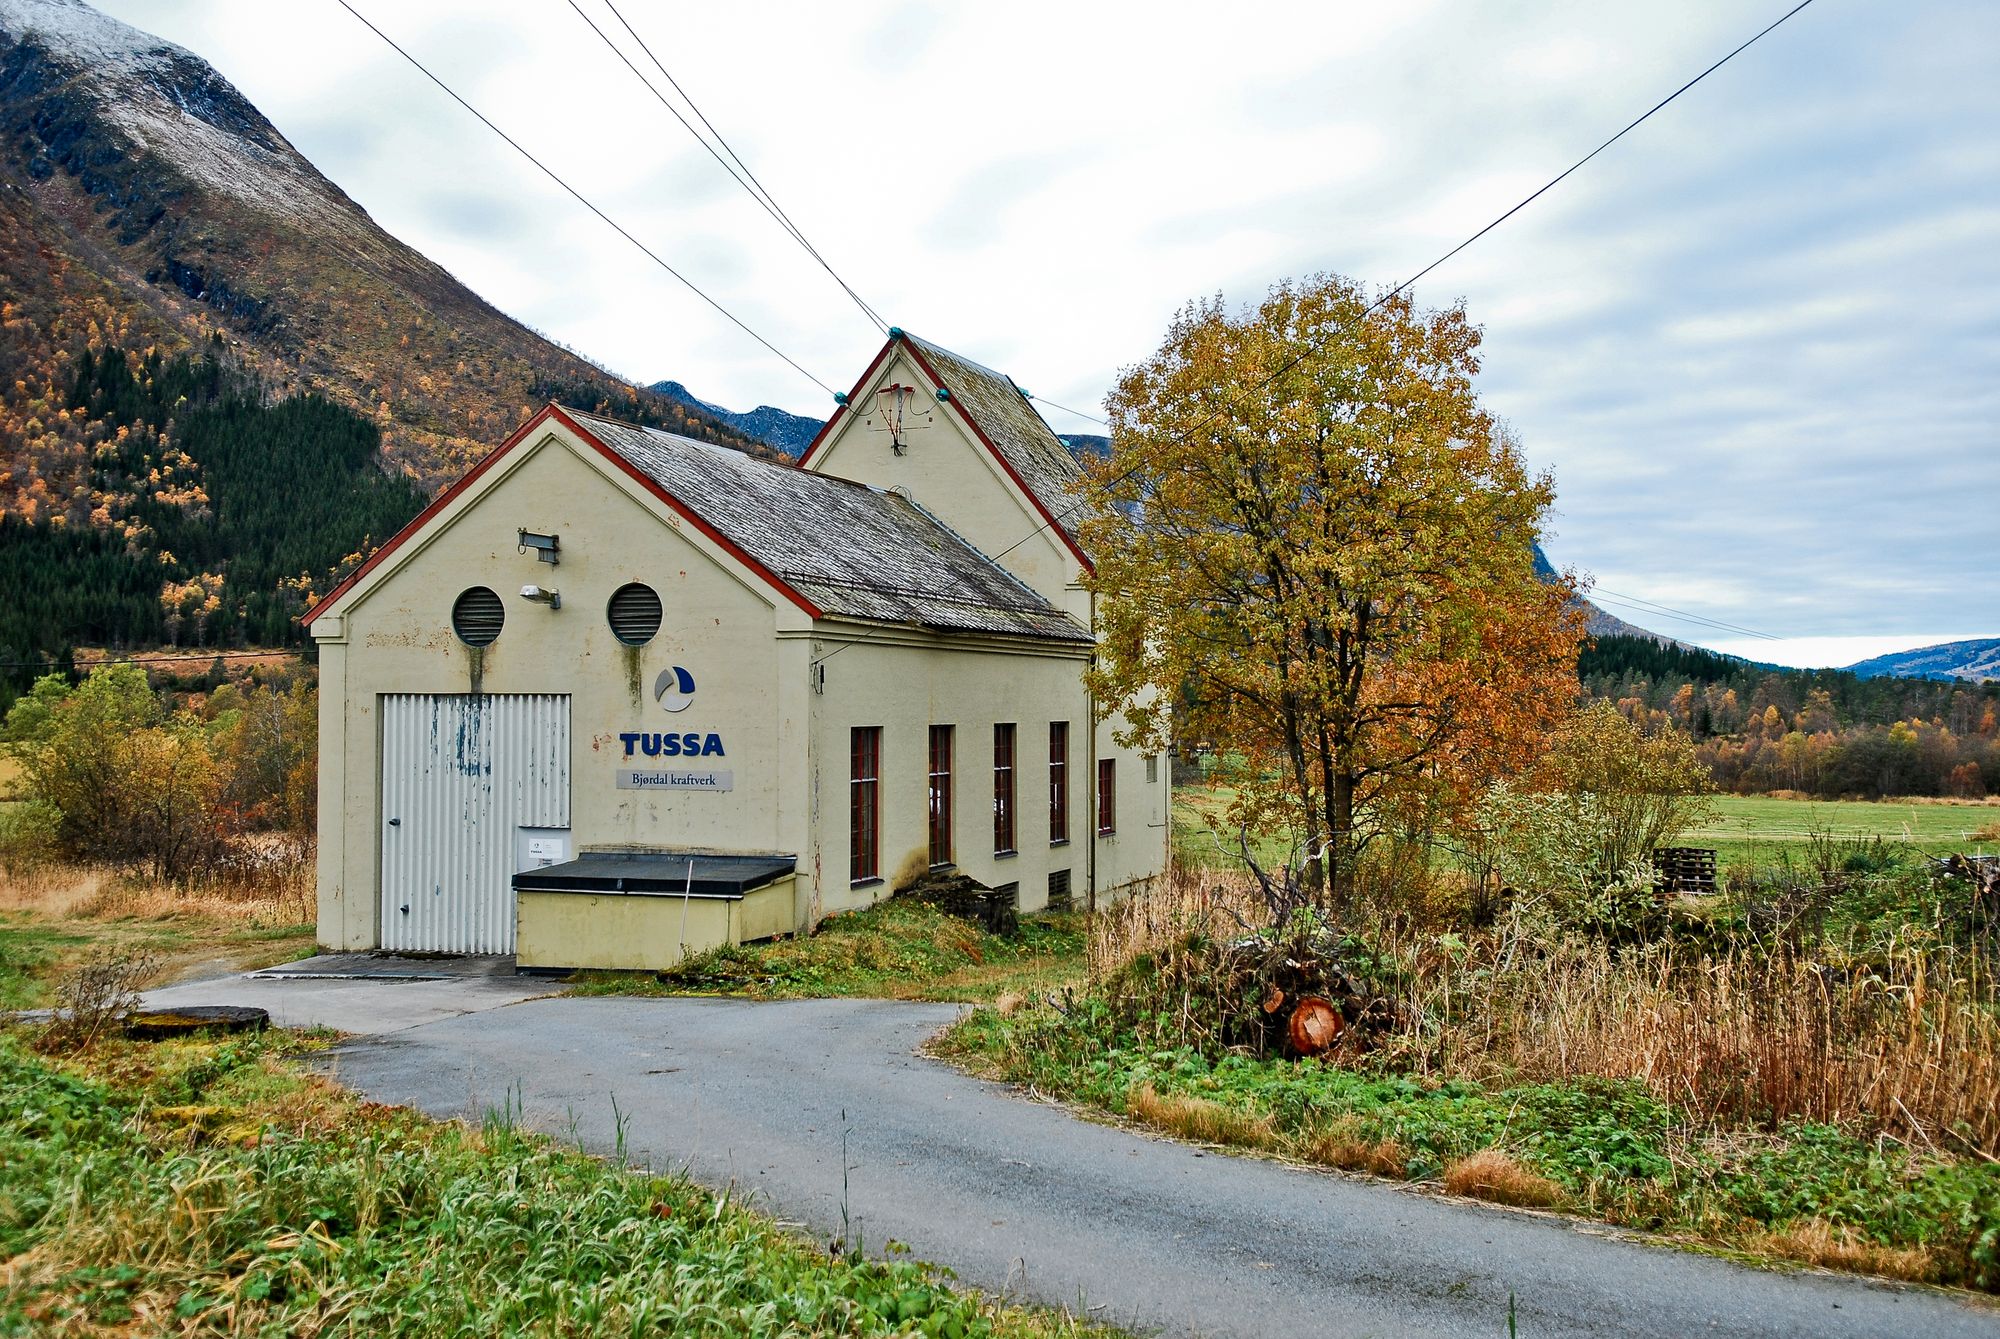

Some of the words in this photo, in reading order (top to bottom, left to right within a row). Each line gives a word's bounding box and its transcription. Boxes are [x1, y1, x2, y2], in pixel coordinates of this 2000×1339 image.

[619, 733, 725, 756] TUSSA
[632, 773, 668, 787] Bjørdal
[670, 774, 716, 786] kraftverk
